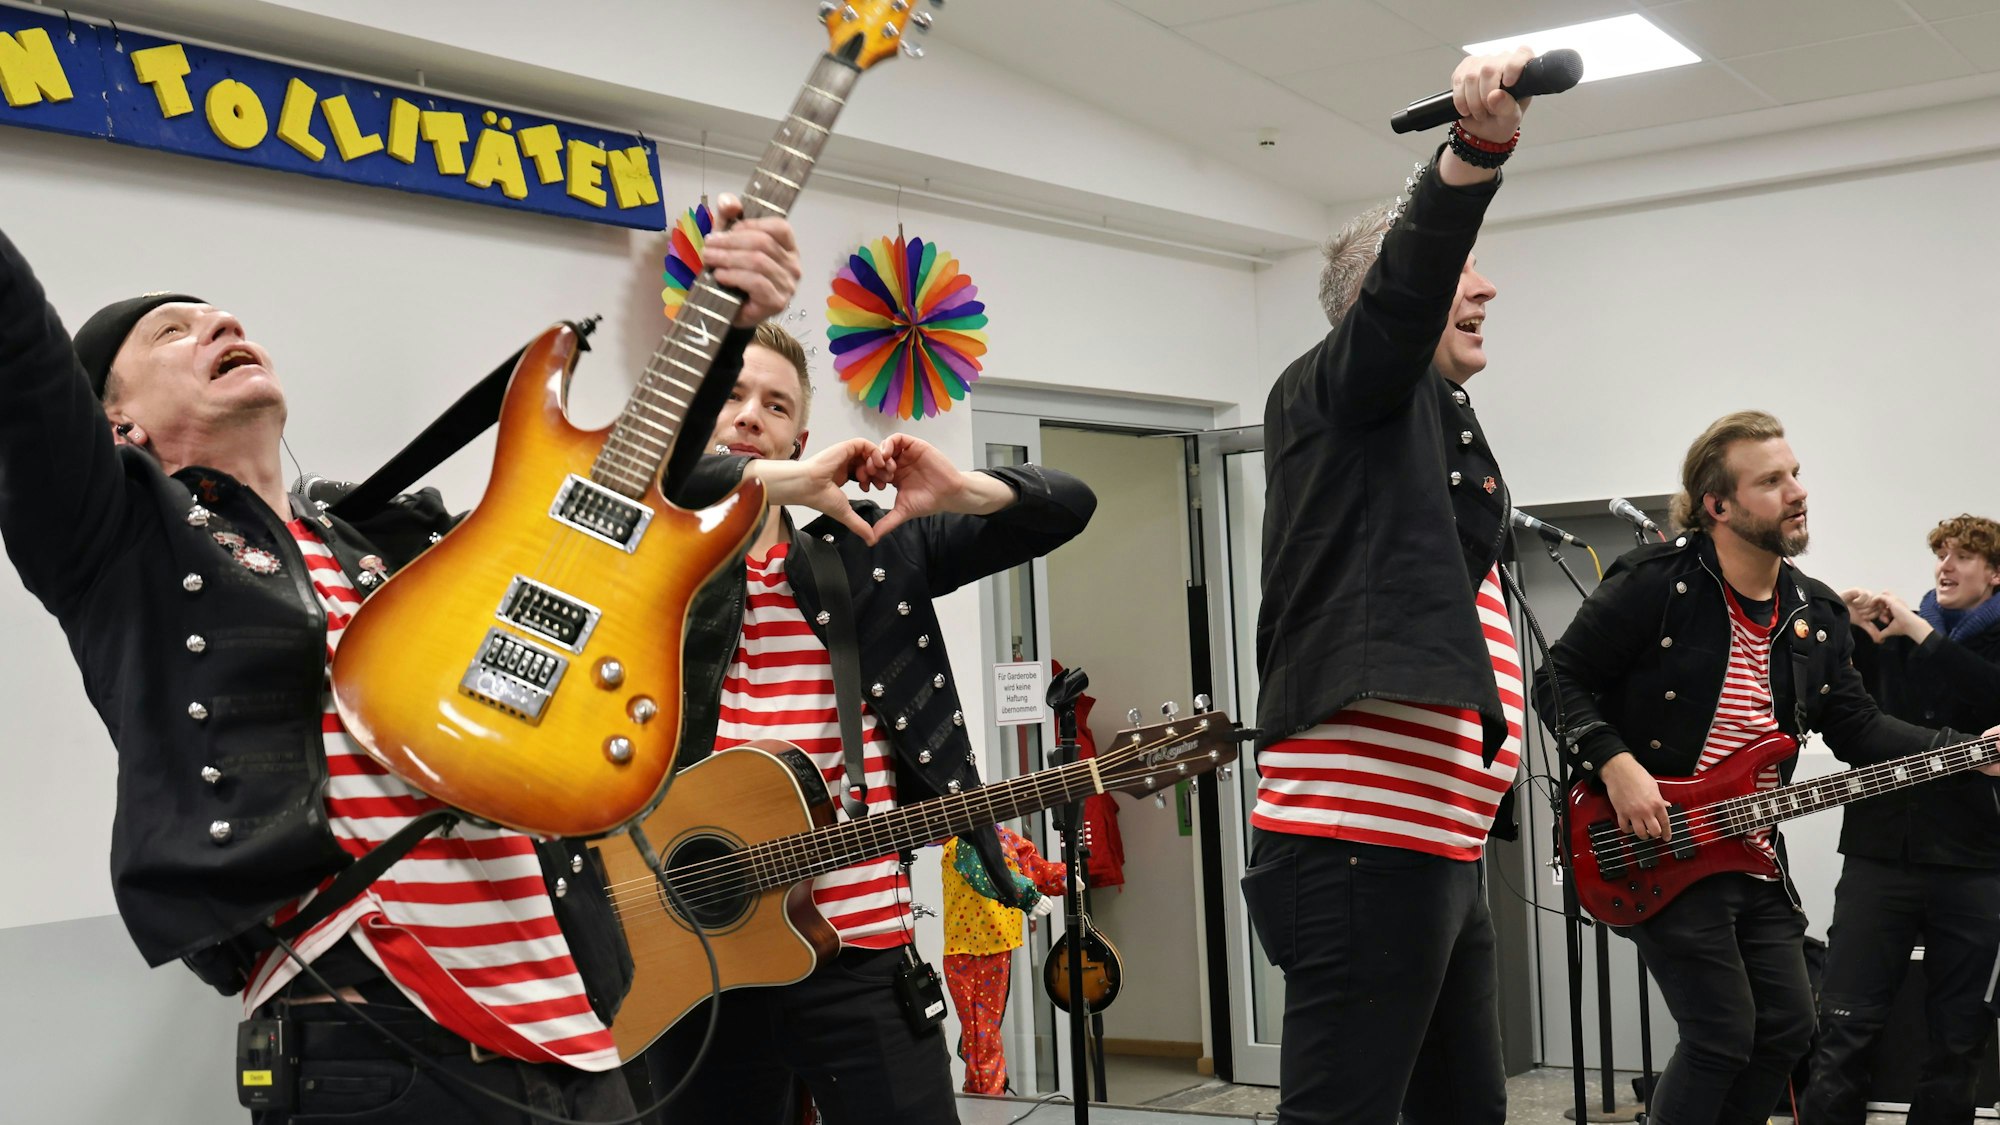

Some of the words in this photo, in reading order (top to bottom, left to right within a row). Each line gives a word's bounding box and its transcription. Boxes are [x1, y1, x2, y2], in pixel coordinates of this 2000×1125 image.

[0, 27, 73, 107] N
[130, 43, 660, 210] TOLLITÄTEN
[998, 672, 1006, 680] Für
[1007, 672, 1037, 680] Garderobe
[1006, 694, 1028, 703] Haftung
[1001, 705, 1037, 714] übernommen
